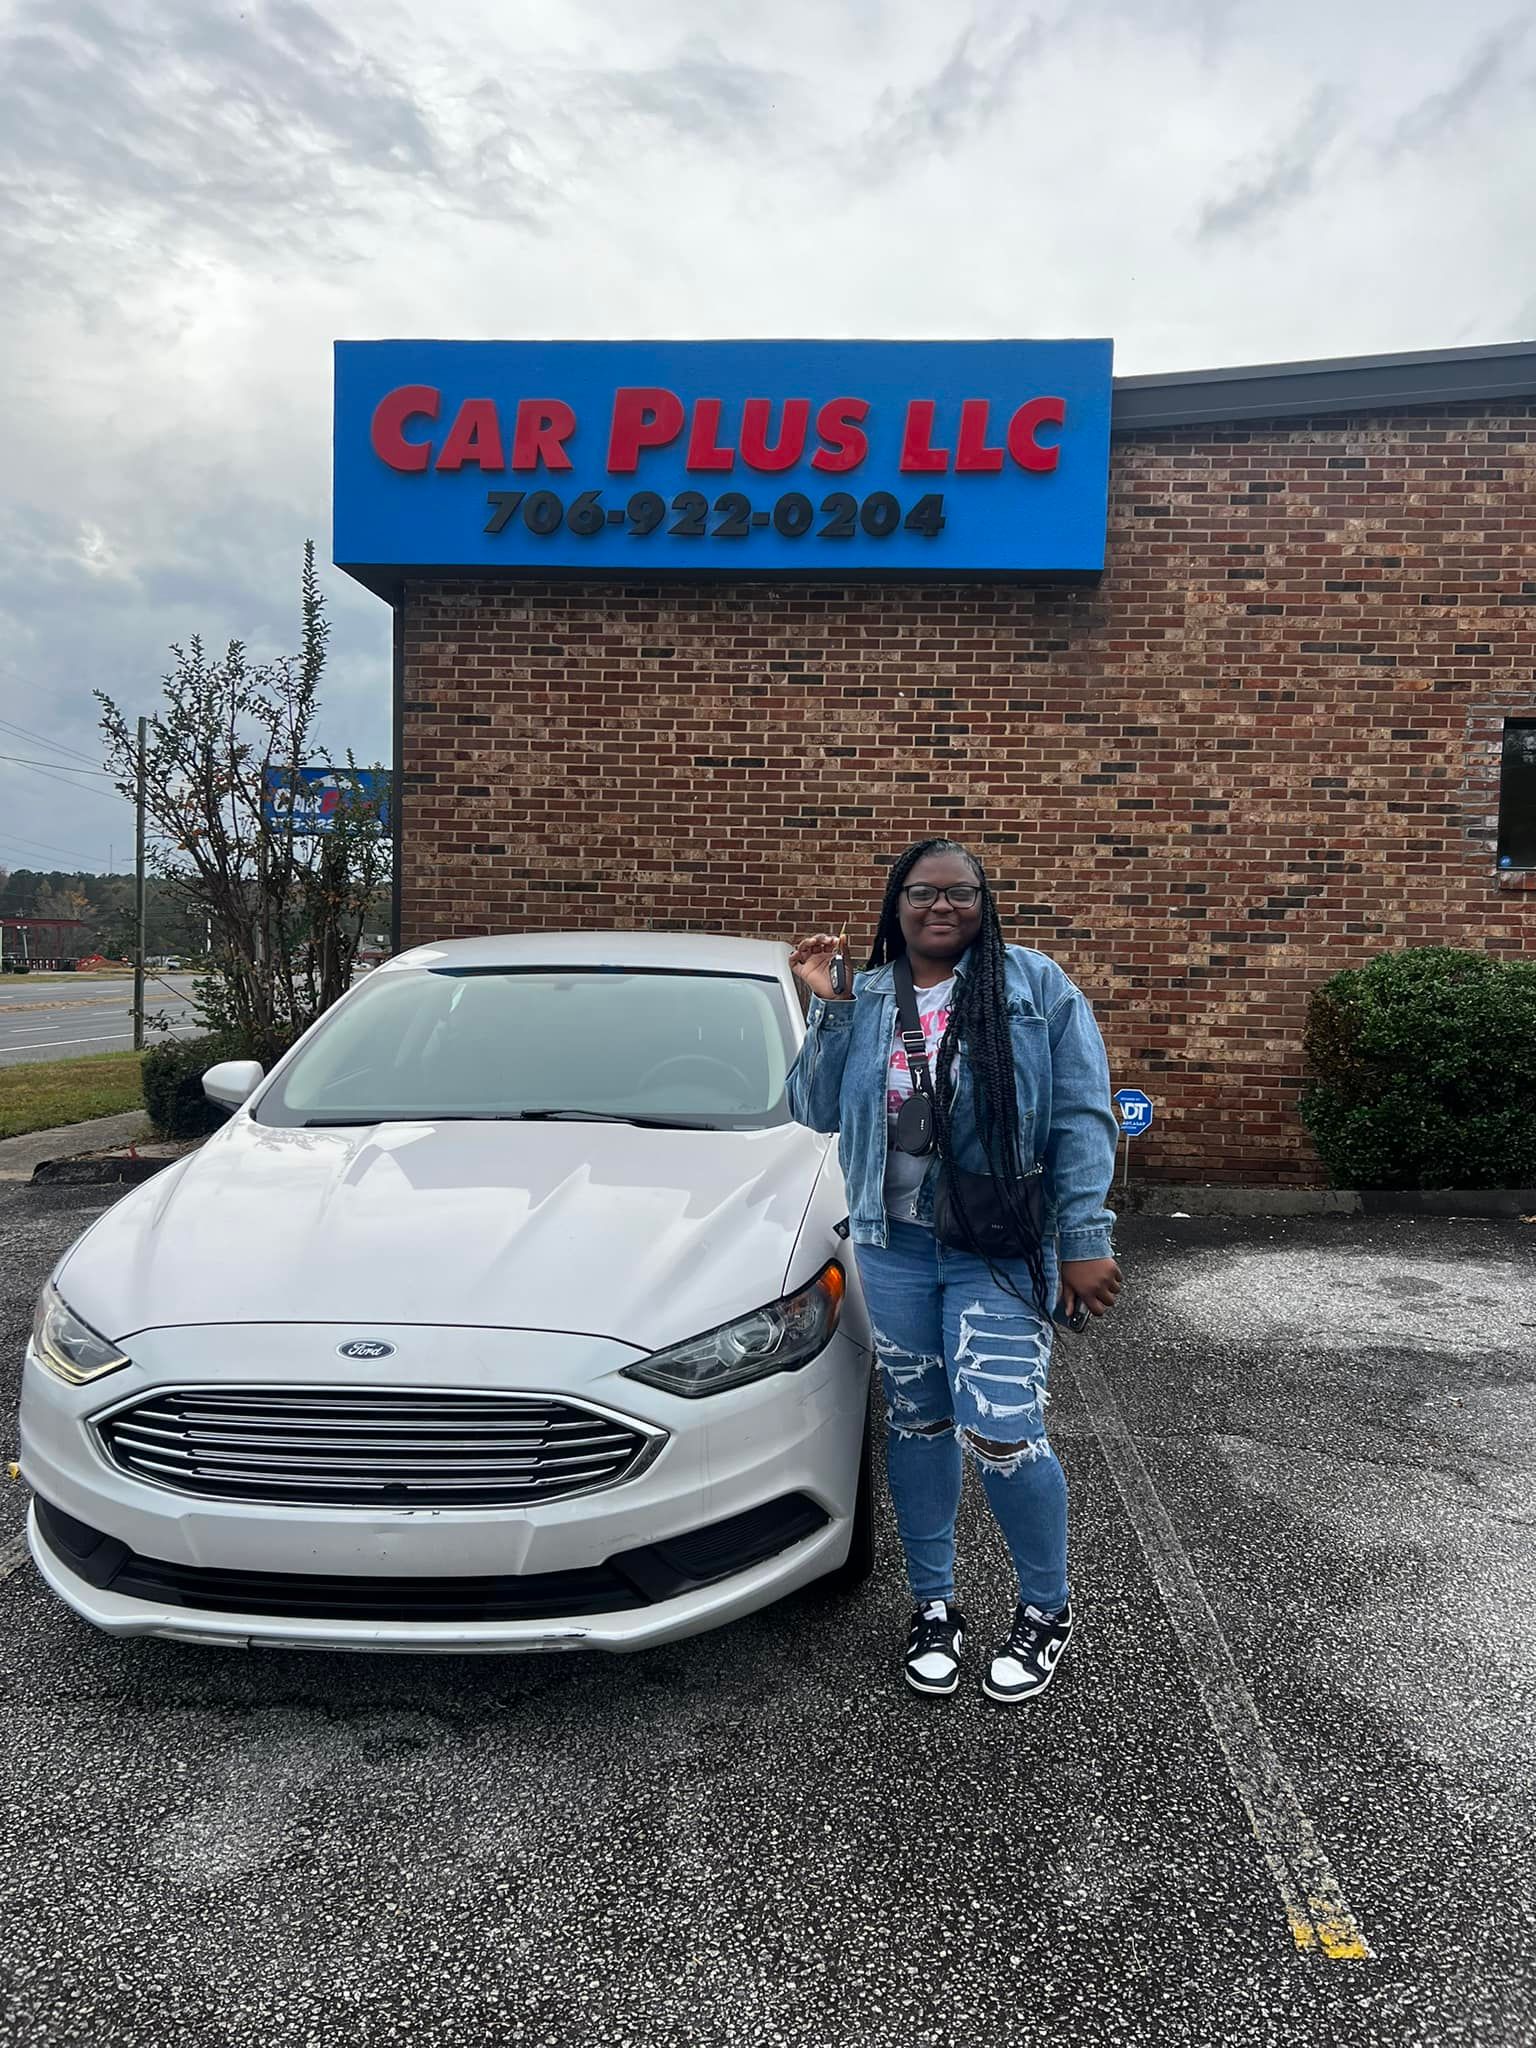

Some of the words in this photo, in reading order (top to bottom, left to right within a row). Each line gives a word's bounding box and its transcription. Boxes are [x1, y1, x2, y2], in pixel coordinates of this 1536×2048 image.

[371, 385, 576, 472] CAR
[607, 387, 870, 472] PLUS
[900, 397, 1066, 472] LLC
[483, 490, 946, 542] 706-922-0204
[347, 1342, 384, 1356] Ford
